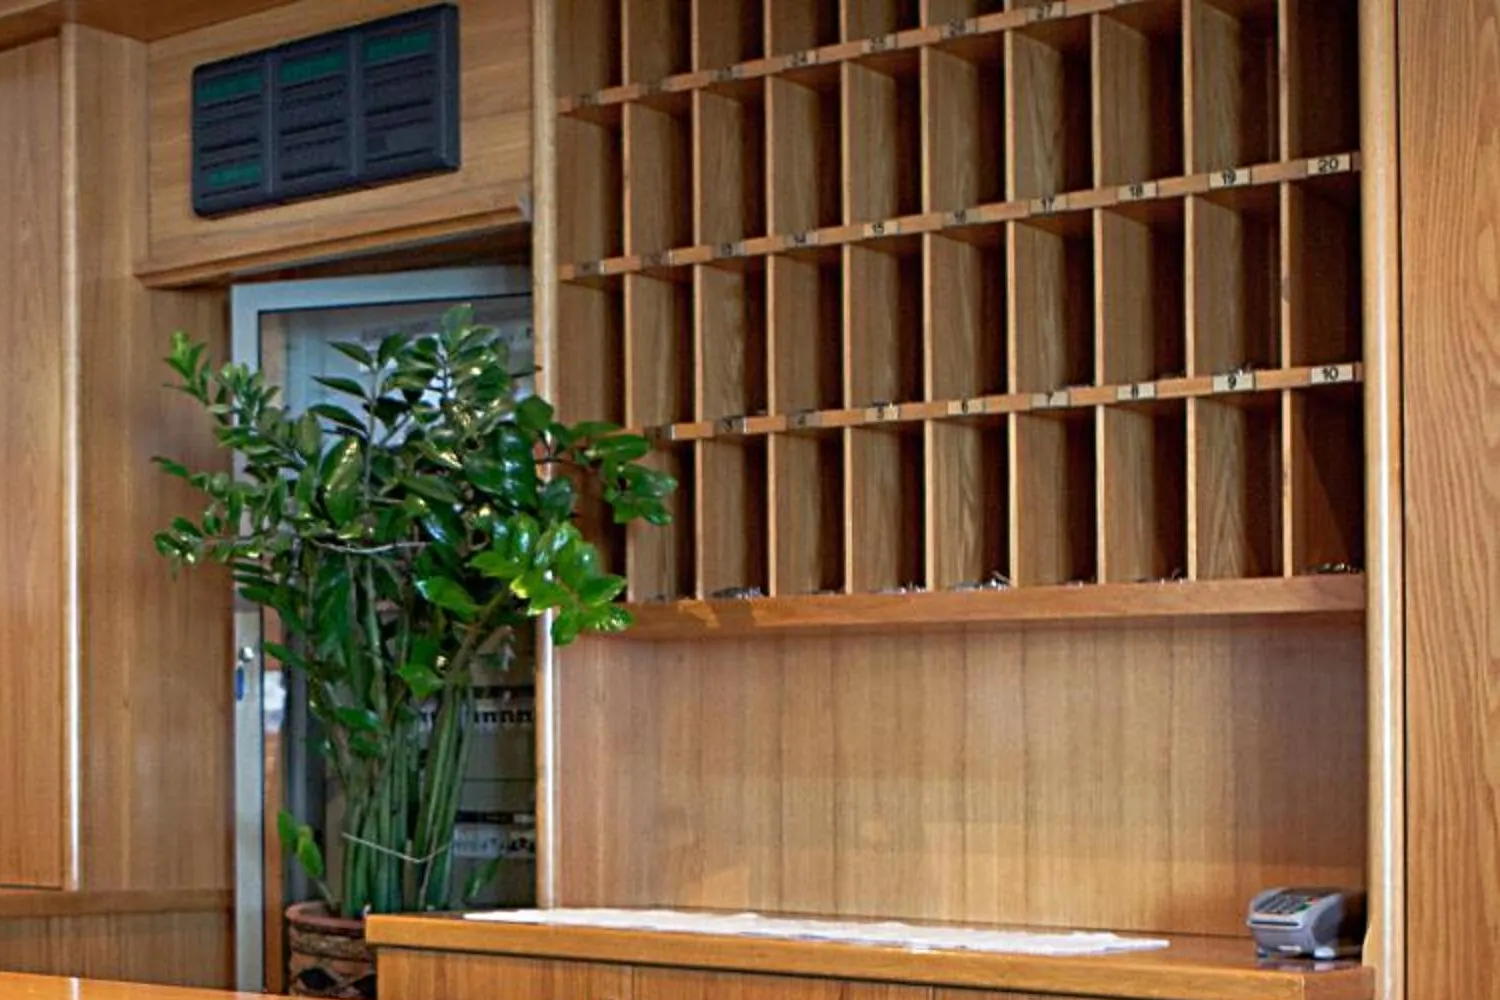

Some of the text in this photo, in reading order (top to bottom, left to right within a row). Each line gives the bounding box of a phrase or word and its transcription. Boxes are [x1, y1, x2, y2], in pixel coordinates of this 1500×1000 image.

[1317, 158, 1339, 173] 20
[1222, 167, 1237, 185] 19
[1227, 373, 1237, 389] 9
[1321, 366, 1339, 381] 10
